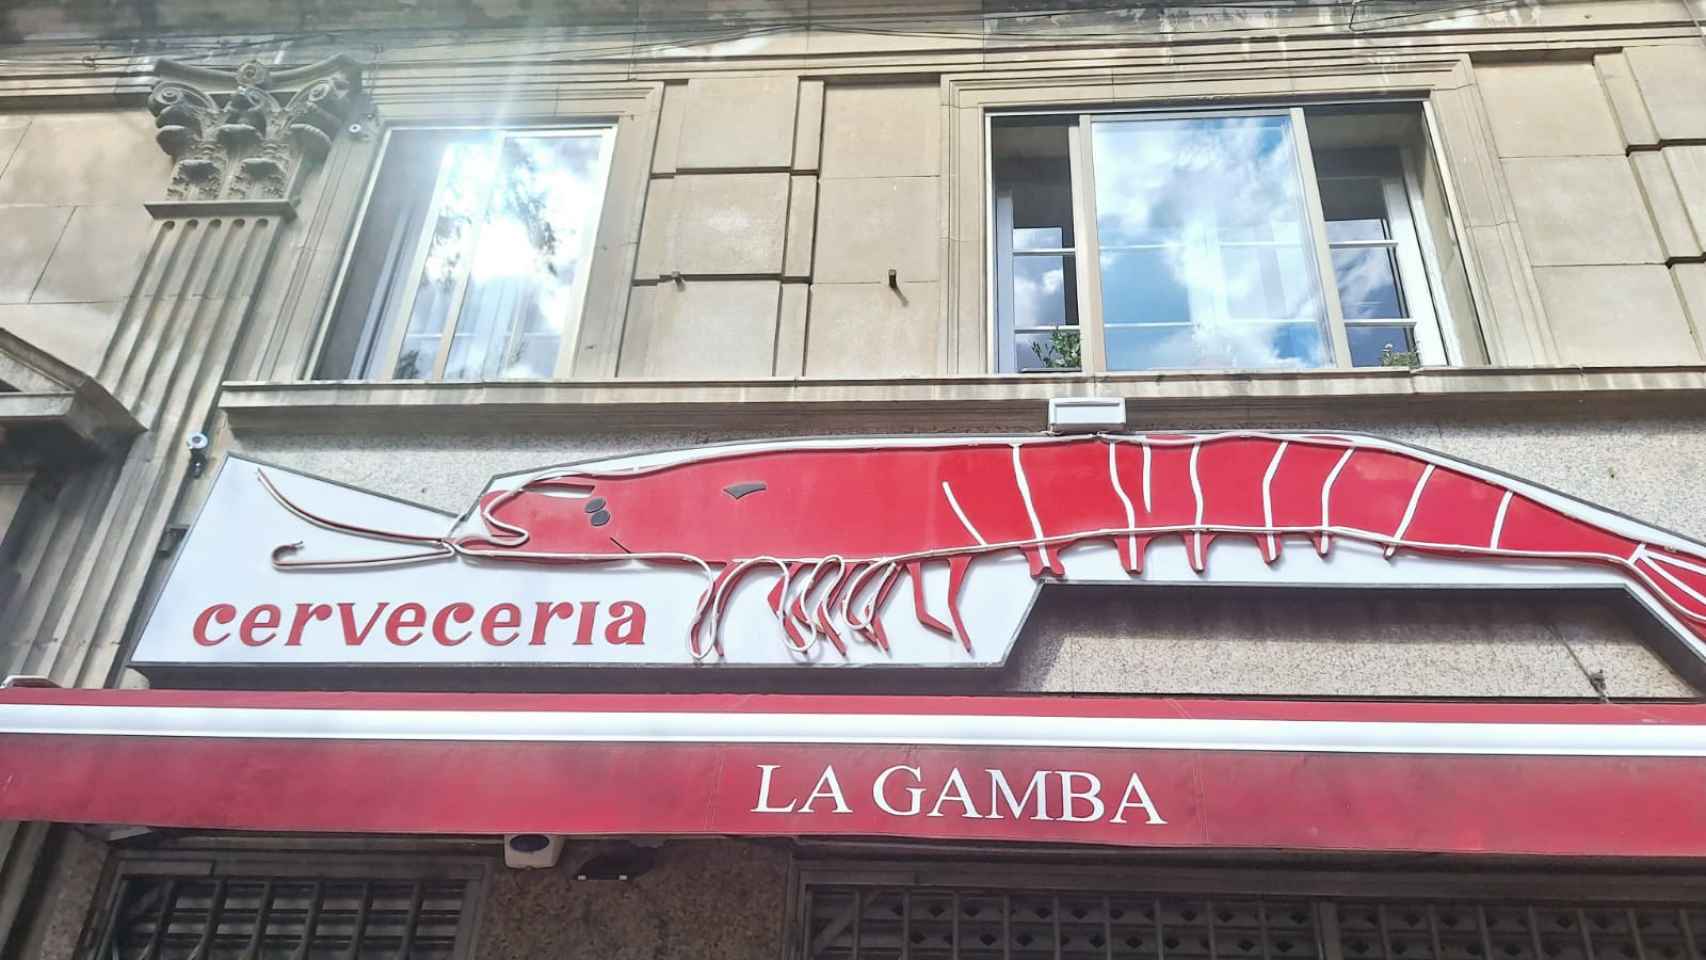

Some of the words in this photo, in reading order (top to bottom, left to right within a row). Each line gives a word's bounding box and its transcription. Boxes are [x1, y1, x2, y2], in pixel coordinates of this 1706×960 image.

[193, 601, 647, 646] cerveceria
[750, 763, 853, 815] LA
[872, 764, 1168, 825] GAMBA
